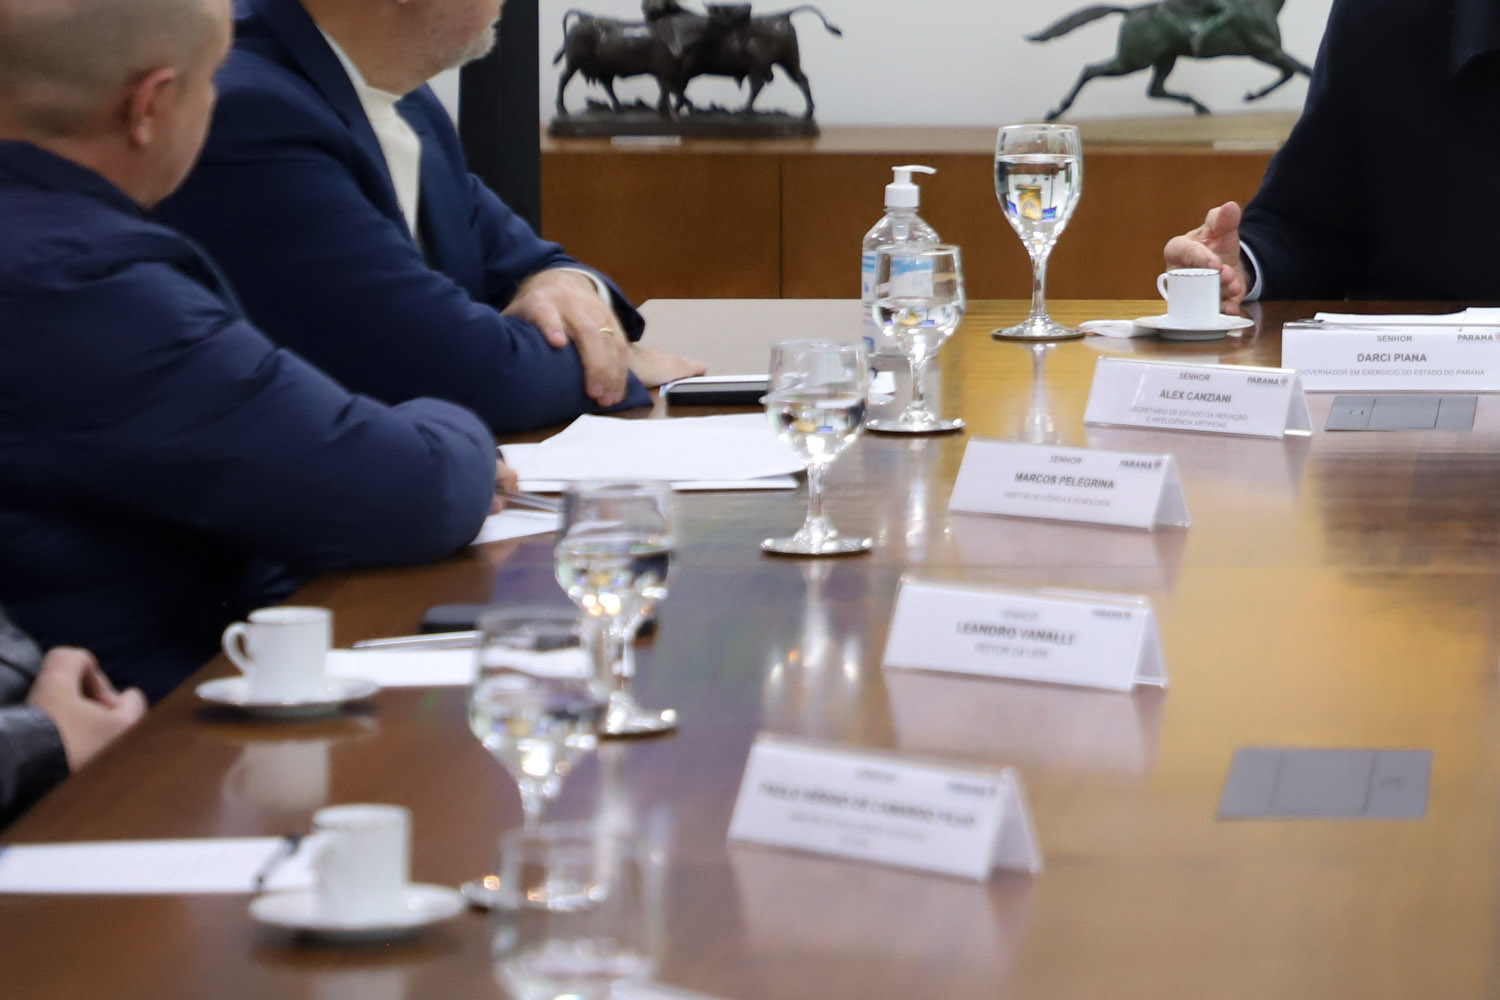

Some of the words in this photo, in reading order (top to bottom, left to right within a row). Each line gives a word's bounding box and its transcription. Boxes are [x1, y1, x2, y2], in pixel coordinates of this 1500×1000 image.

[1357, 353, 1391, 362] DARCI
[1394, 353, 1427, 362] PIANA
[1178, 372, 1210, 382] SENHOR
[1159, 389, 1184, 400] ALEX
[1186, 391, 1231, 404] CANZIANI
[1049, 455, 1082, 465] SENHOR
[1014, 472, 1057, 485] MARCOS
[1057, 476, 1115, 491] PELEGRINA
[956, 622, 1017, 639] LEANDRO
